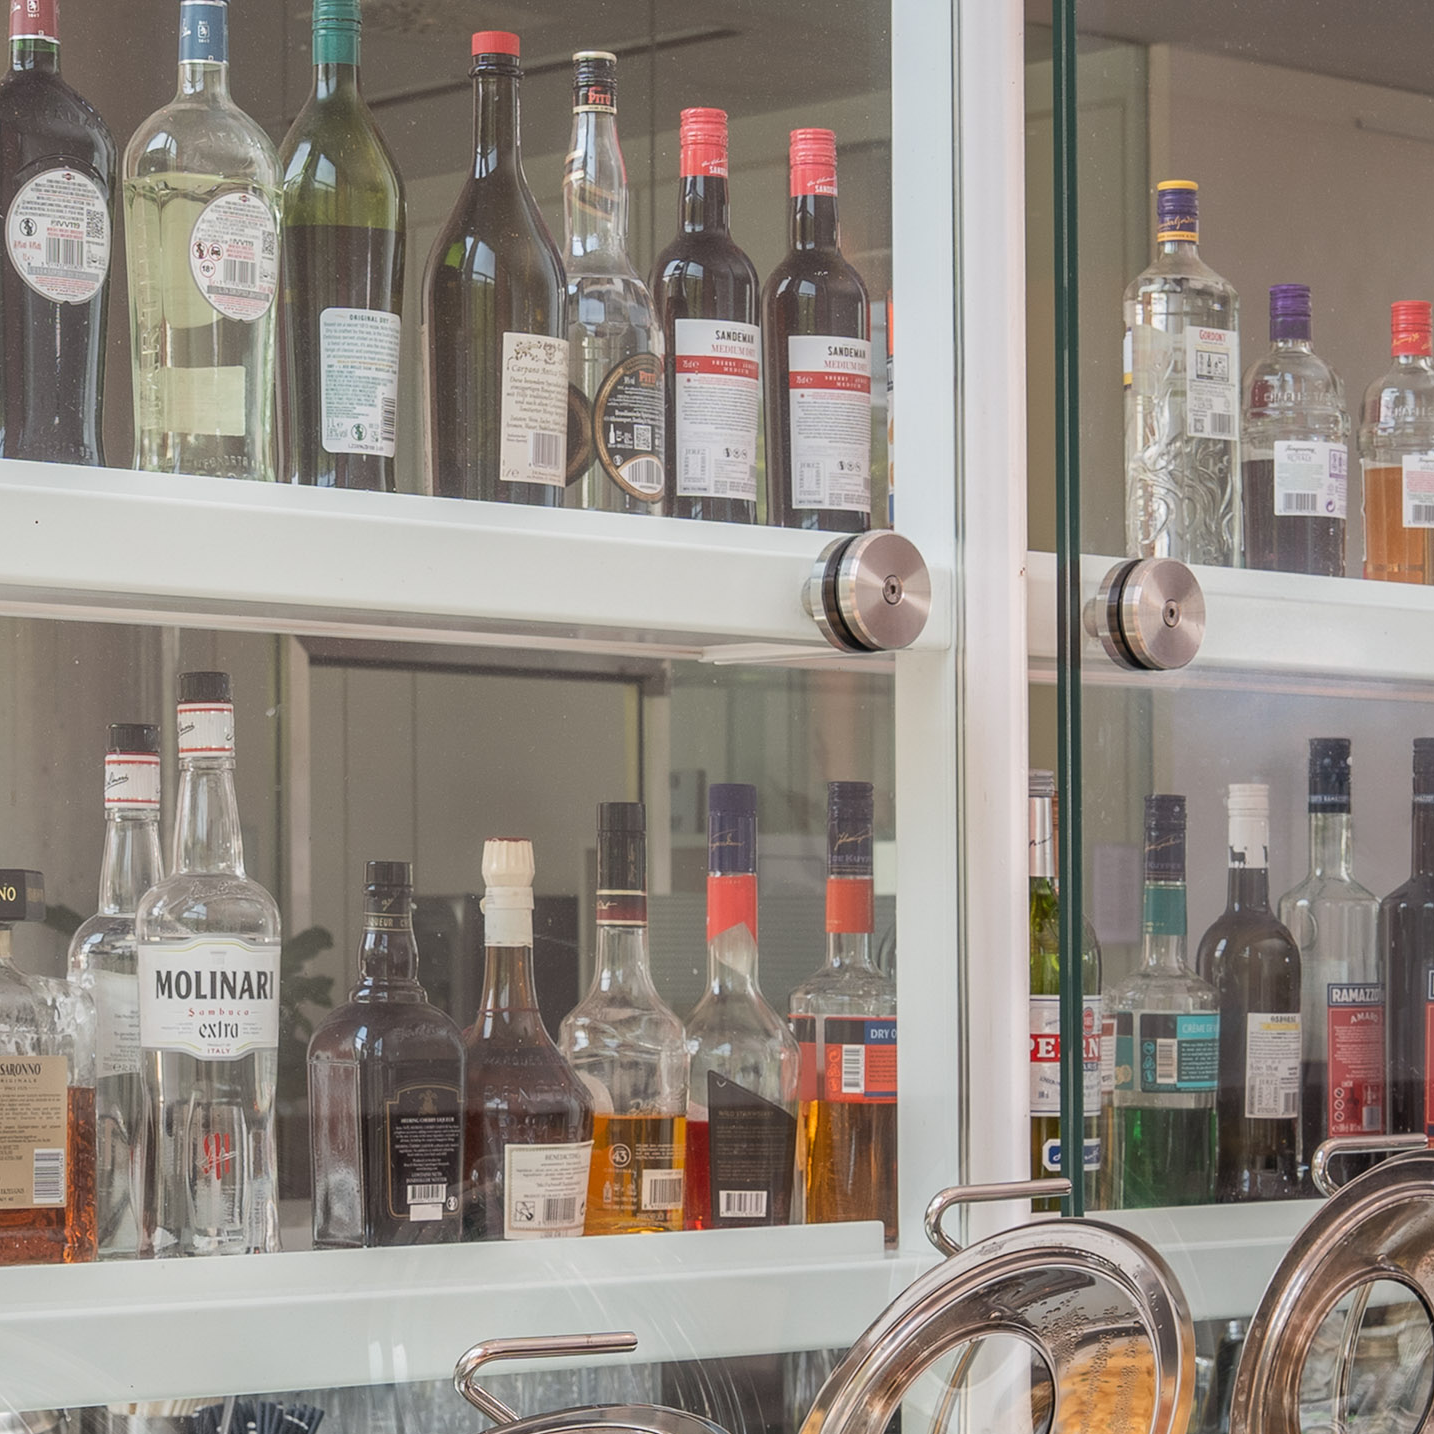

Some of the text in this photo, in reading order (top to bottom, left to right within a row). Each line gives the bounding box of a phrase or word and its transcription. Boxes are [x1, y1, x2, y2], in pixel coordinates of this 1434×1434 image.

[715, 329, 755, 345] SANDEMAN
[827, 345, 867, 359] SANDEMAN
[511, 364, 540, 377] Carpano
[155, 969, 274, 1000] MOLINARI
[187, 1007, 250, 1018] Sambuca
[1350, 1012, 1378, 1024] AMARO
[198, 1020, 239, 1039] extra
[870, 1028, 890, 1039] DRY
[612, 1150, 628, 1163] 43
